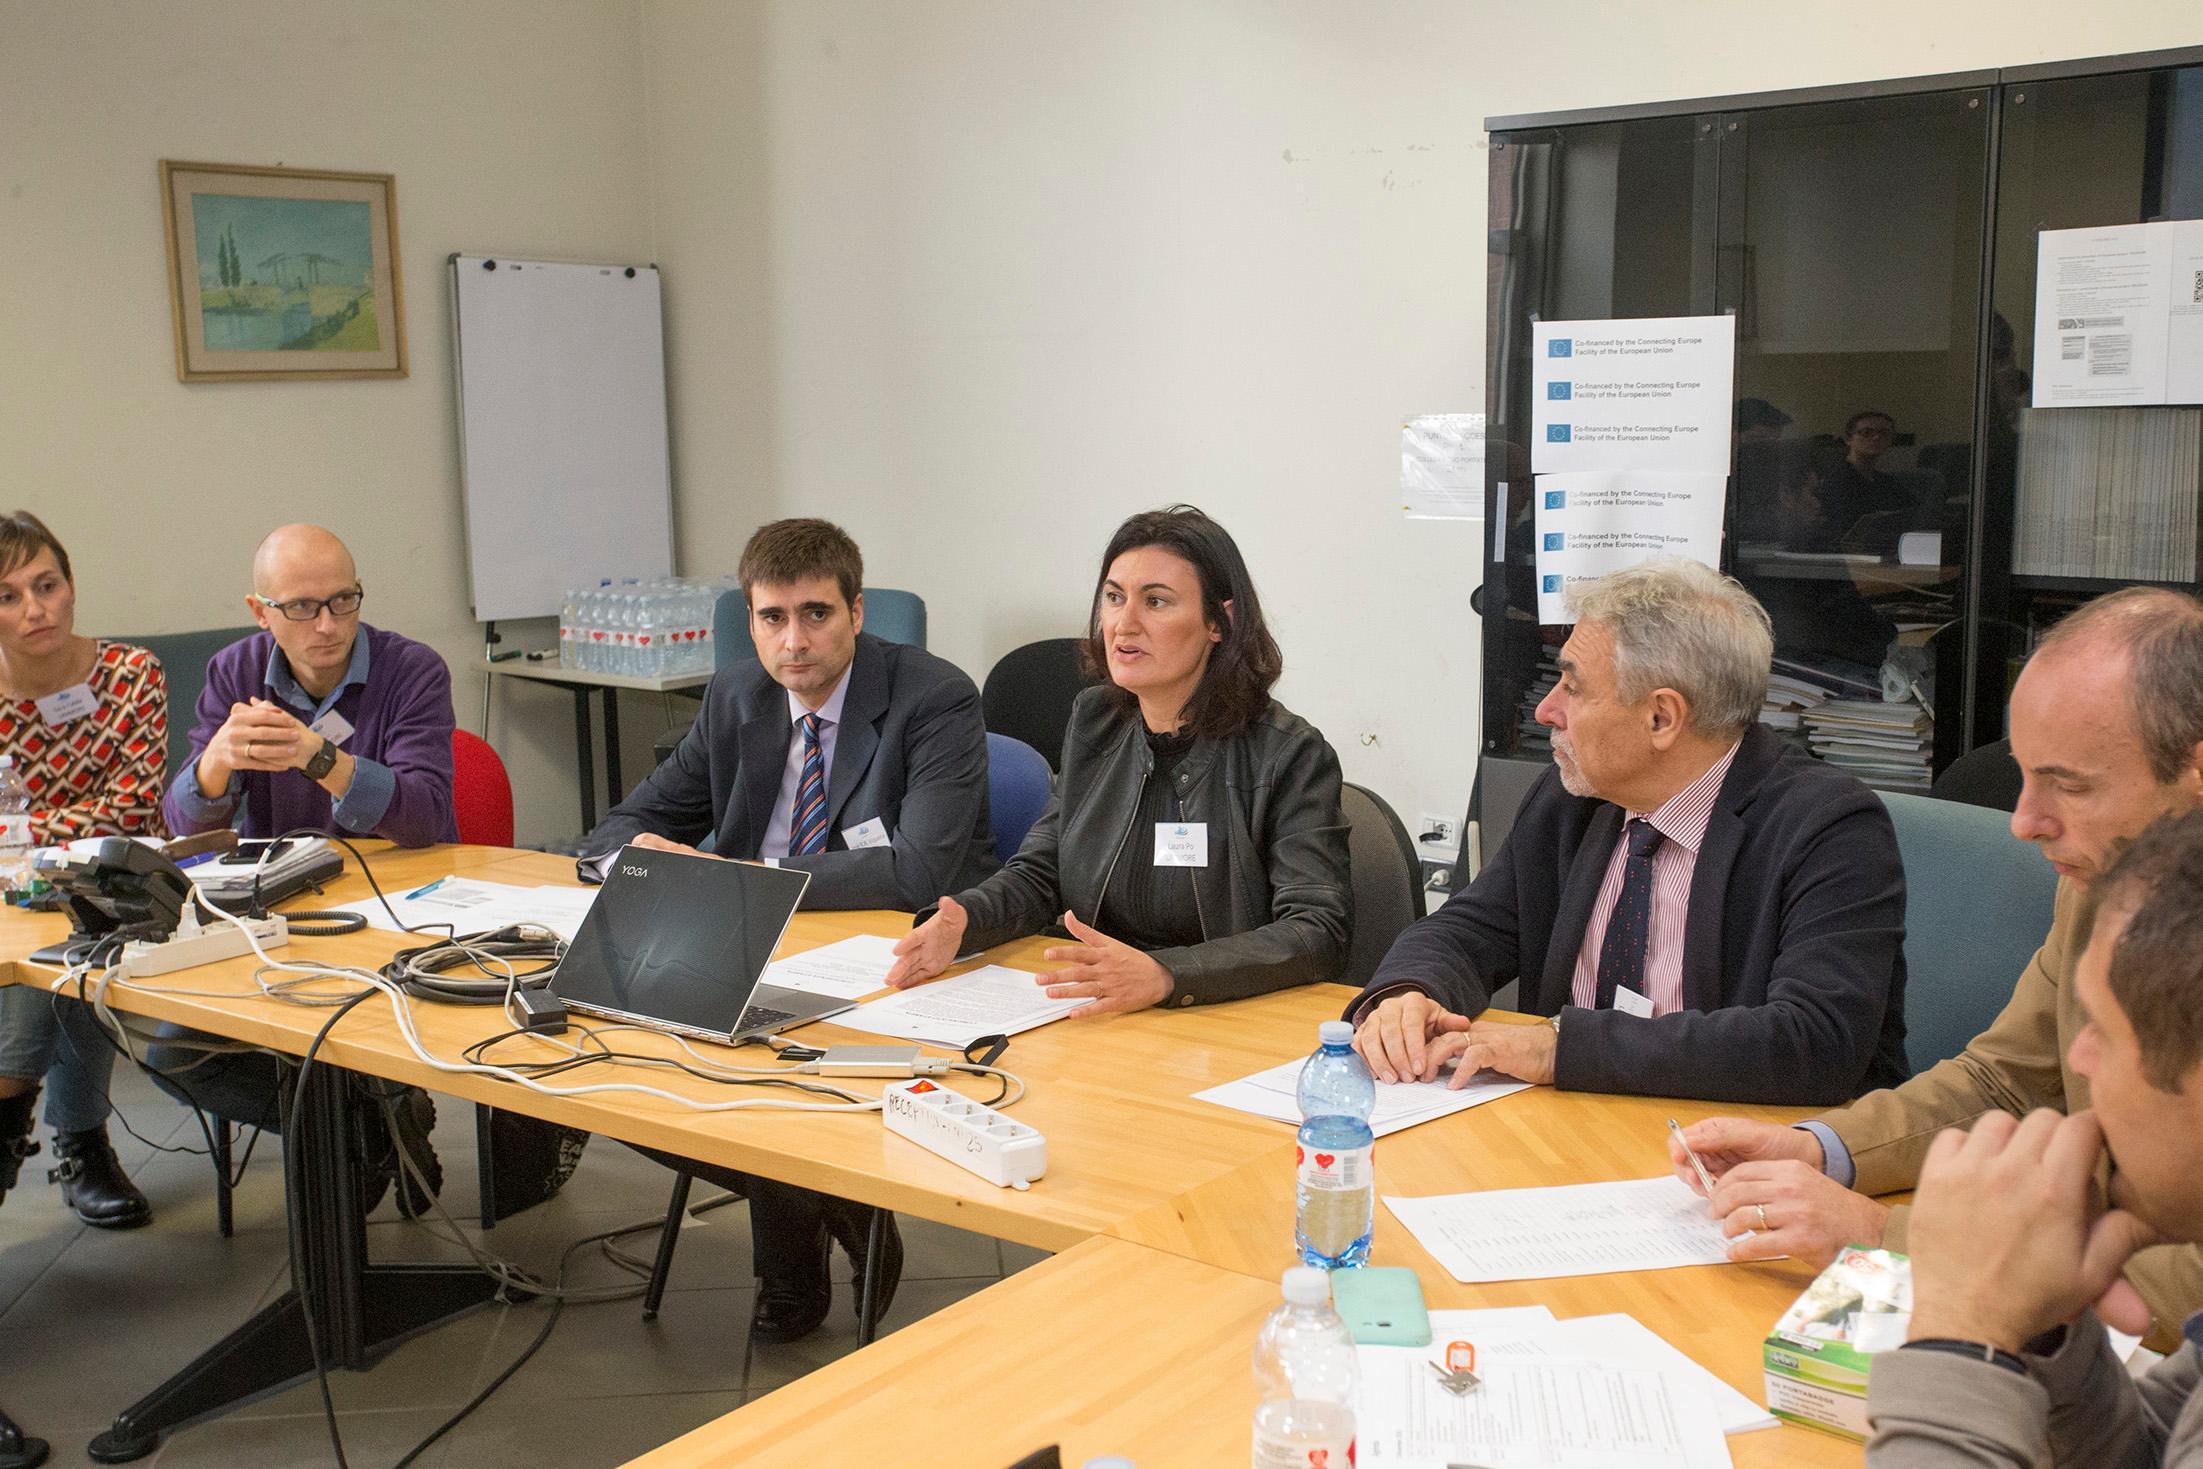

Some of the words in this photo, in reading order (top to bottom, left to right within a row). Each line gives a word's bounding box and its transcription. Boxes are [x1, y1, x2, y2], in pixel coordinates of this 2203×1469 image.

[1575, 339, 1615, 347] Co-financed
[1637, 338, 1677, 346] Connecting
[1575, 348, 1598, 356] Facility
[1619, 347, 1652, 355] European
[1574, 382, 1613, 390] Co-financed
[1613, 382, 1622, 391] by
[1635, 382, 1674, 390] Connecting
[1675, 381, 1700, 389] Europe
[1574, 392, 1597, 400] Facility
[1618, 391, 1650, 399] European
[1574, 425, 1611, 433] Co-financed
[1612, 425, 1621, 433] by
[1634, 425, 1673, 433] Connecting
[1674, 425, 1699, 433] Europe
[1574, 434, 1596, 442] Facility
[1617, 434, 1649, 442] European
[1610, 490, 1619, 498] by
[1633, 490, 1666, 499] Connecting
[1667, 491, 1692, 500] Europe
[1567, 533, 1609, 541] Co-financed
[1610, 533, 1619, 541] by
[1633, 532, 1665, 542] Connecting
[1666, 535, 1689, 544] Europe
[1567, 542, 1592, 550] Facility
[1593, 541, 1601, 549] of
[622, 865, 648, 878] YOGA
